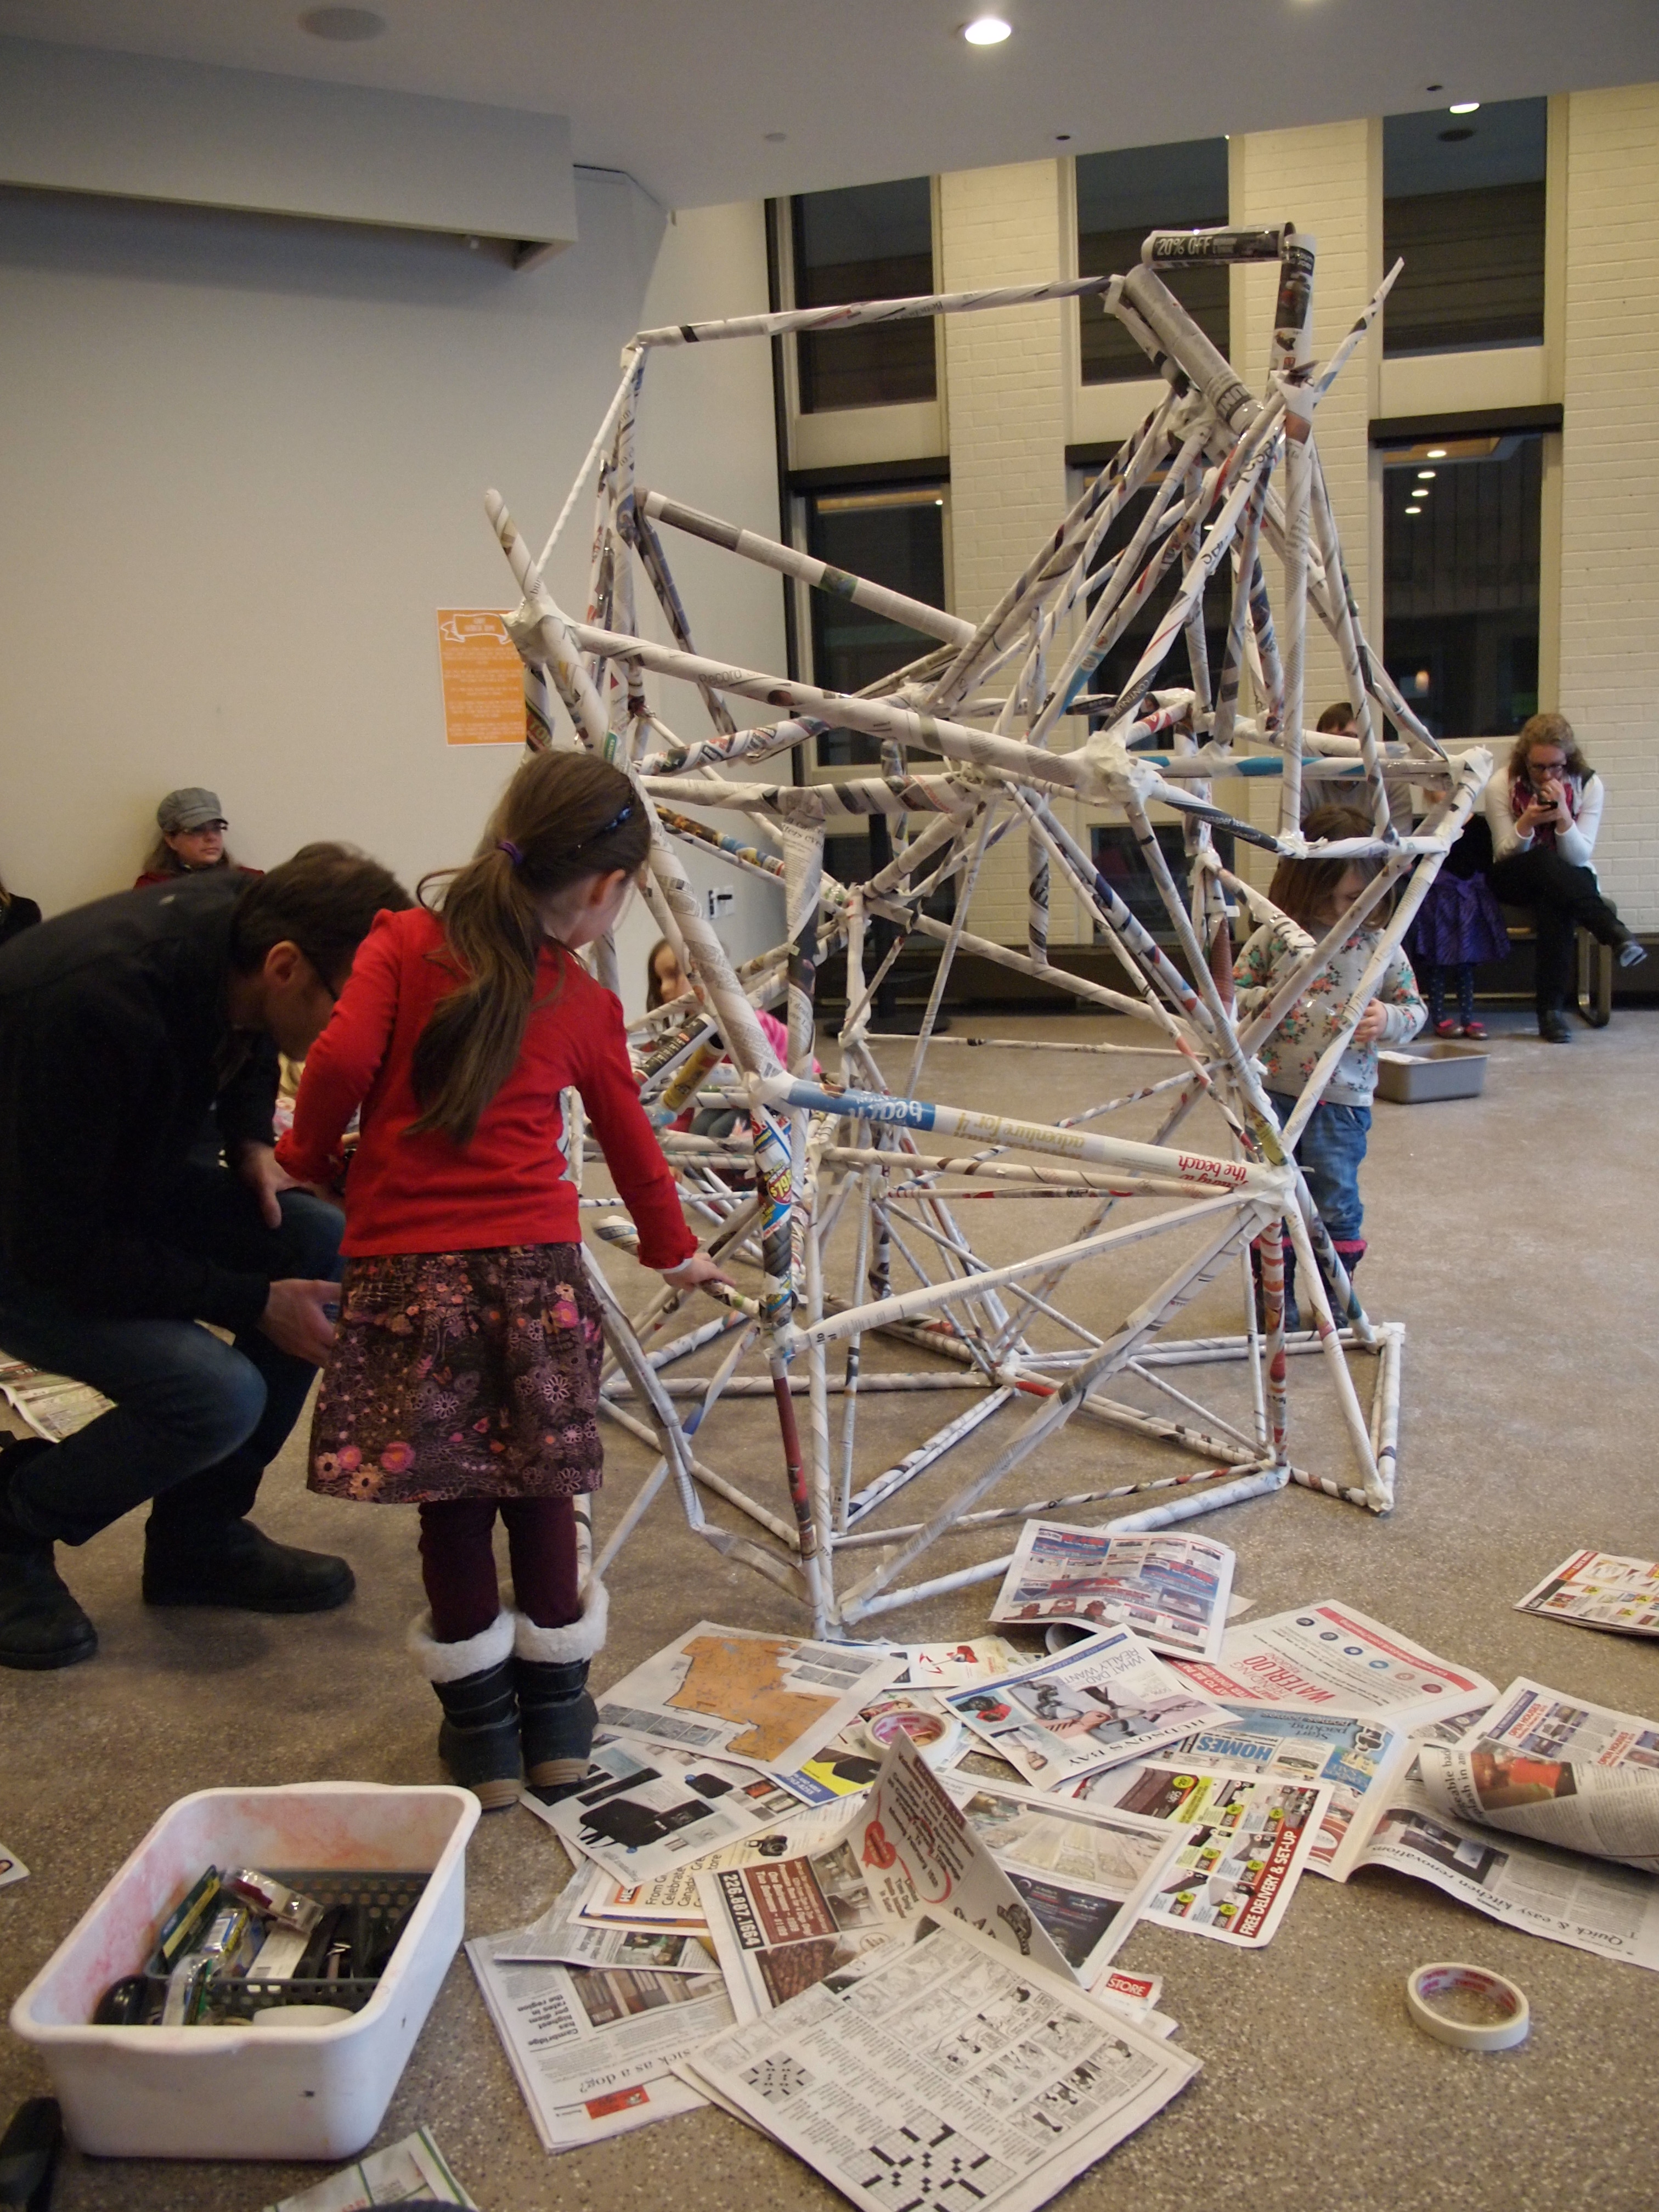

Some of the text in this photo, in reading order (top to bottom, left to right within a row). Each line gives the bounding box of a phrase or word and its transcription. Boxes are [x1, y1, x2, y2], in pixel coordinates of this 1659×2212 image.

[1156, 238, 1186, 256] 20%
[1188, 236, 1214, 255] OFF
[1178, 1155, 1222, 1178] beach
[1224, 1164, 1248, 1182] the
[1057, 1646, 1139, 1690] REALLY WANTS
[1085, 1653, 1146, 1688] WHAT DAD
[1229, 1661, 1290, 1699] TRENDING
[1243, 1655, 1336, 1703] WATERLOO
[1508, 1721, 1528, 1737] OPEN
[1521, 1702, 1542, 1725] HOUSES
[1109, 1718, 1205, 1752] HUDSON'S
[1197, 1735, 1273, 1761] HOMES
[1597, 1747, 1617, 1766] OPEN
[1610, 1730, 1629, 1751] HOUSES
[1068, 1749, 1107, 1767] BAY
[662, 1866, 685, 1906] Celebrate
[1239, 1830, 1297, 1936] FREE DELIVERY & SET-UP
[1371, 1843, 1624, 1947] Quick & easy kitchen renovations
[645, 1888, 661, 1906] From
[721, 1874, 761, 1948] 226.887.1664
[1107, 1977, 1147, 1996] STORE
[517, 1993, 564, 2012] the region
[528, 2007, 569, 2024] per diem
[542, 2000, 566, 2013] rates
[538, 2014, 573, 2030] highest
[558, 2021, 576, 2030] has
[527, 2028, 579, 2046] Cambridge
[578, 2048, 691, 2094] sick as a dog?
